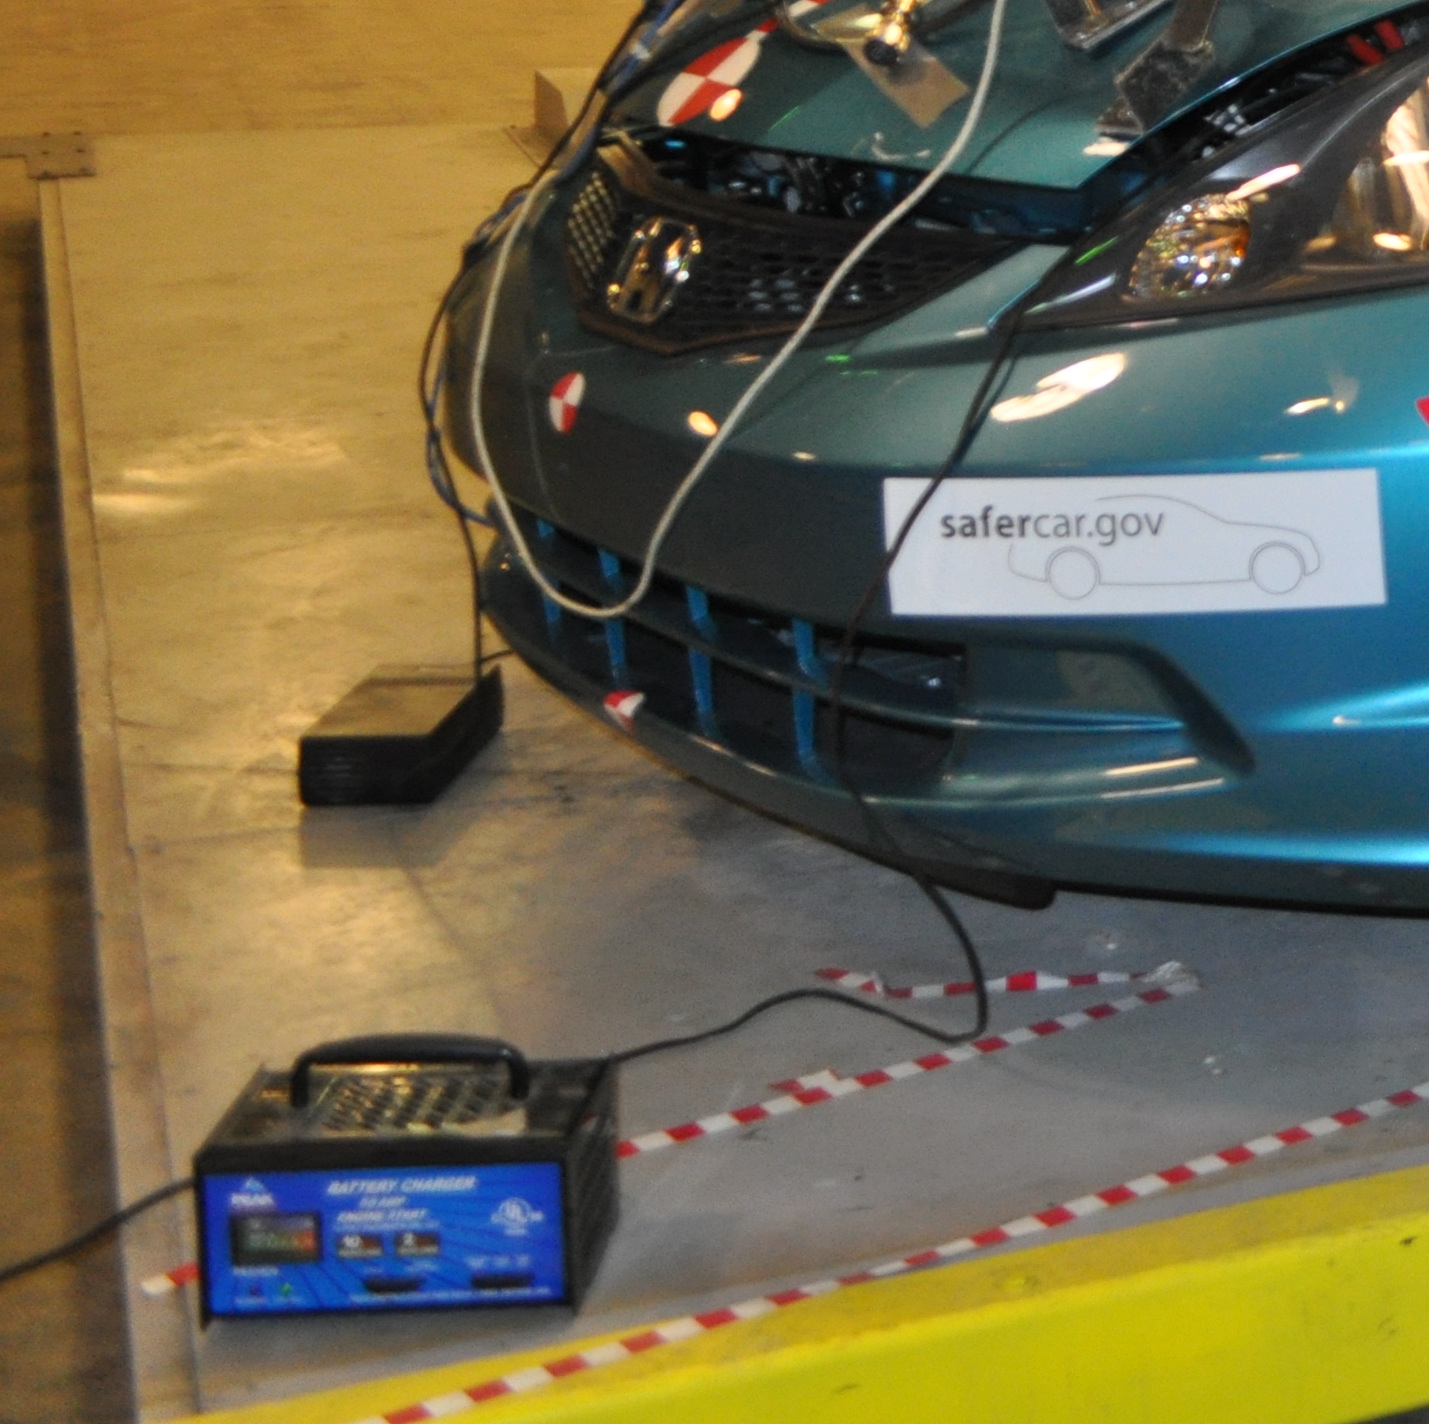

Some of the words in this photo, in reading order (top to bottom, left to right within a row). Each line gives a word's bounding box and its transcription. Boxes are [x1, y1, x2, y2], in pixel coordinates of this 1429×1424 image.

[940, 504, 1165, 546] safercar.gov
[327, 1178, 398, 1195] BATTERY
[401, 1176, 477, 1193] CHARGER
